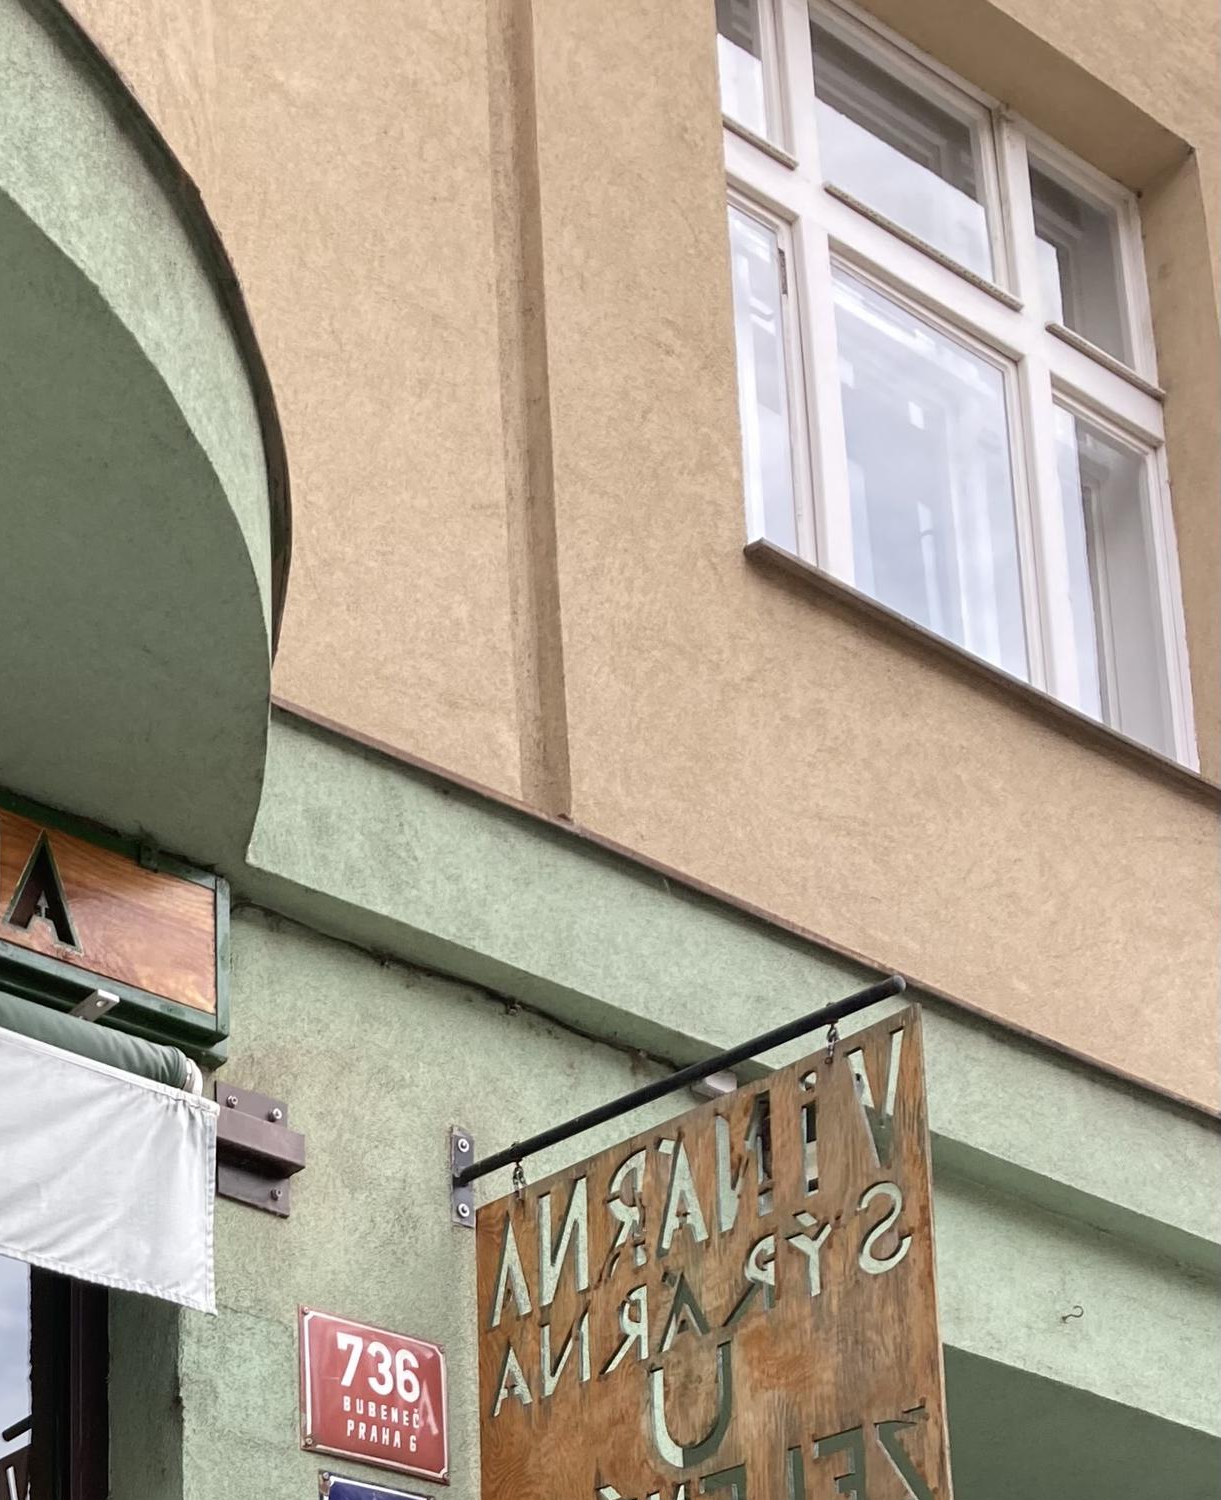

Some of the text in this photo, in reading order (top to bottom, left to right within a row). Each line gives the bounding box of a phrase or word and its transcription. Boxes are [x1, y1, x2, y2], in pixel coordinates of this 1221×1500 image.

[336, 1331, 420, 1403] 736
[343, 1396, 420, 1429] BUBENEČ
[347, 1419, 417, 1452] PRAHA 6
